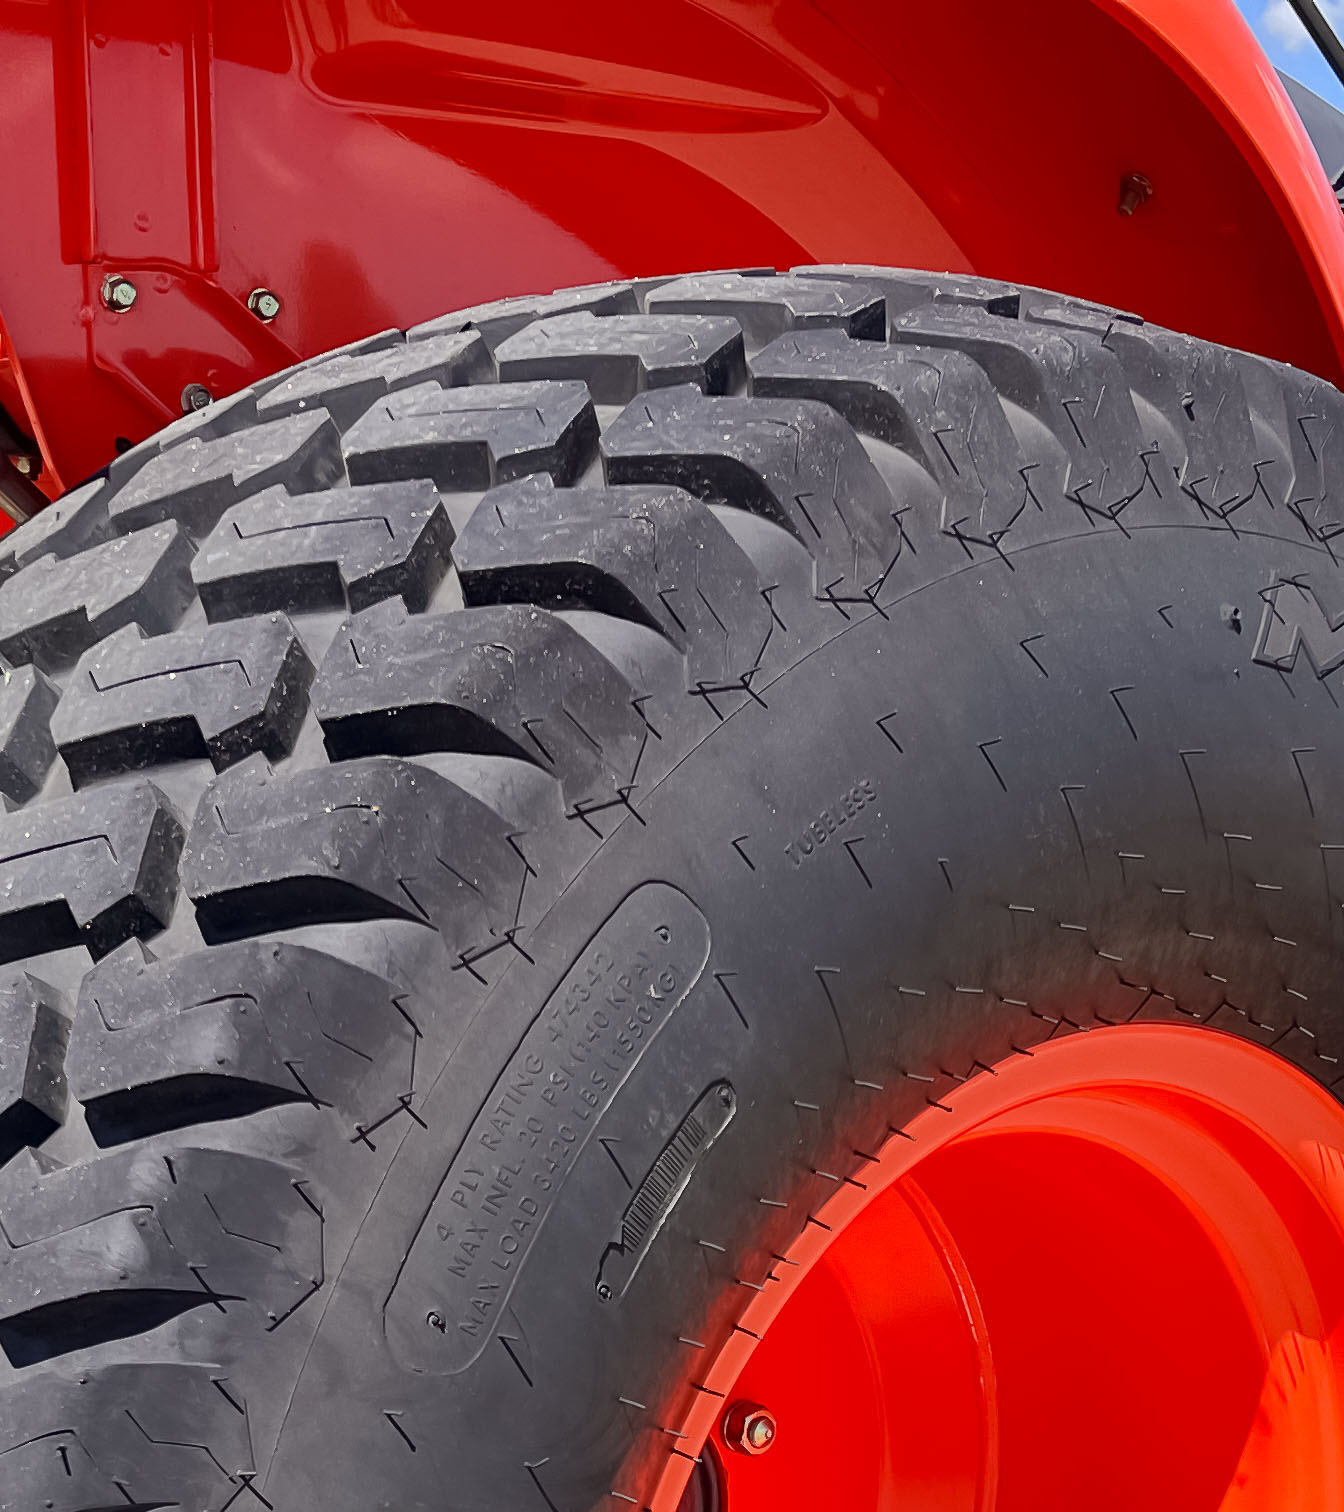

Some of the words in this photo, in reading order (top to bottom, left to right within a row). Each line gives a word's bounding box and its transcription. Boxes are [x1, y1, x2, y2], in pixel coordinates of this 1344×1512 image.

[783, 780, 879, 868] TUBELESS
[450, 1168, 484, 1209] PLY
[480, 1054, 544, 1151] RATING
[447, 1220, 488, 1278] MAX
[459, 1284, 500, 1337] MAX
[491, 1196, 538, 1270] LOAD
